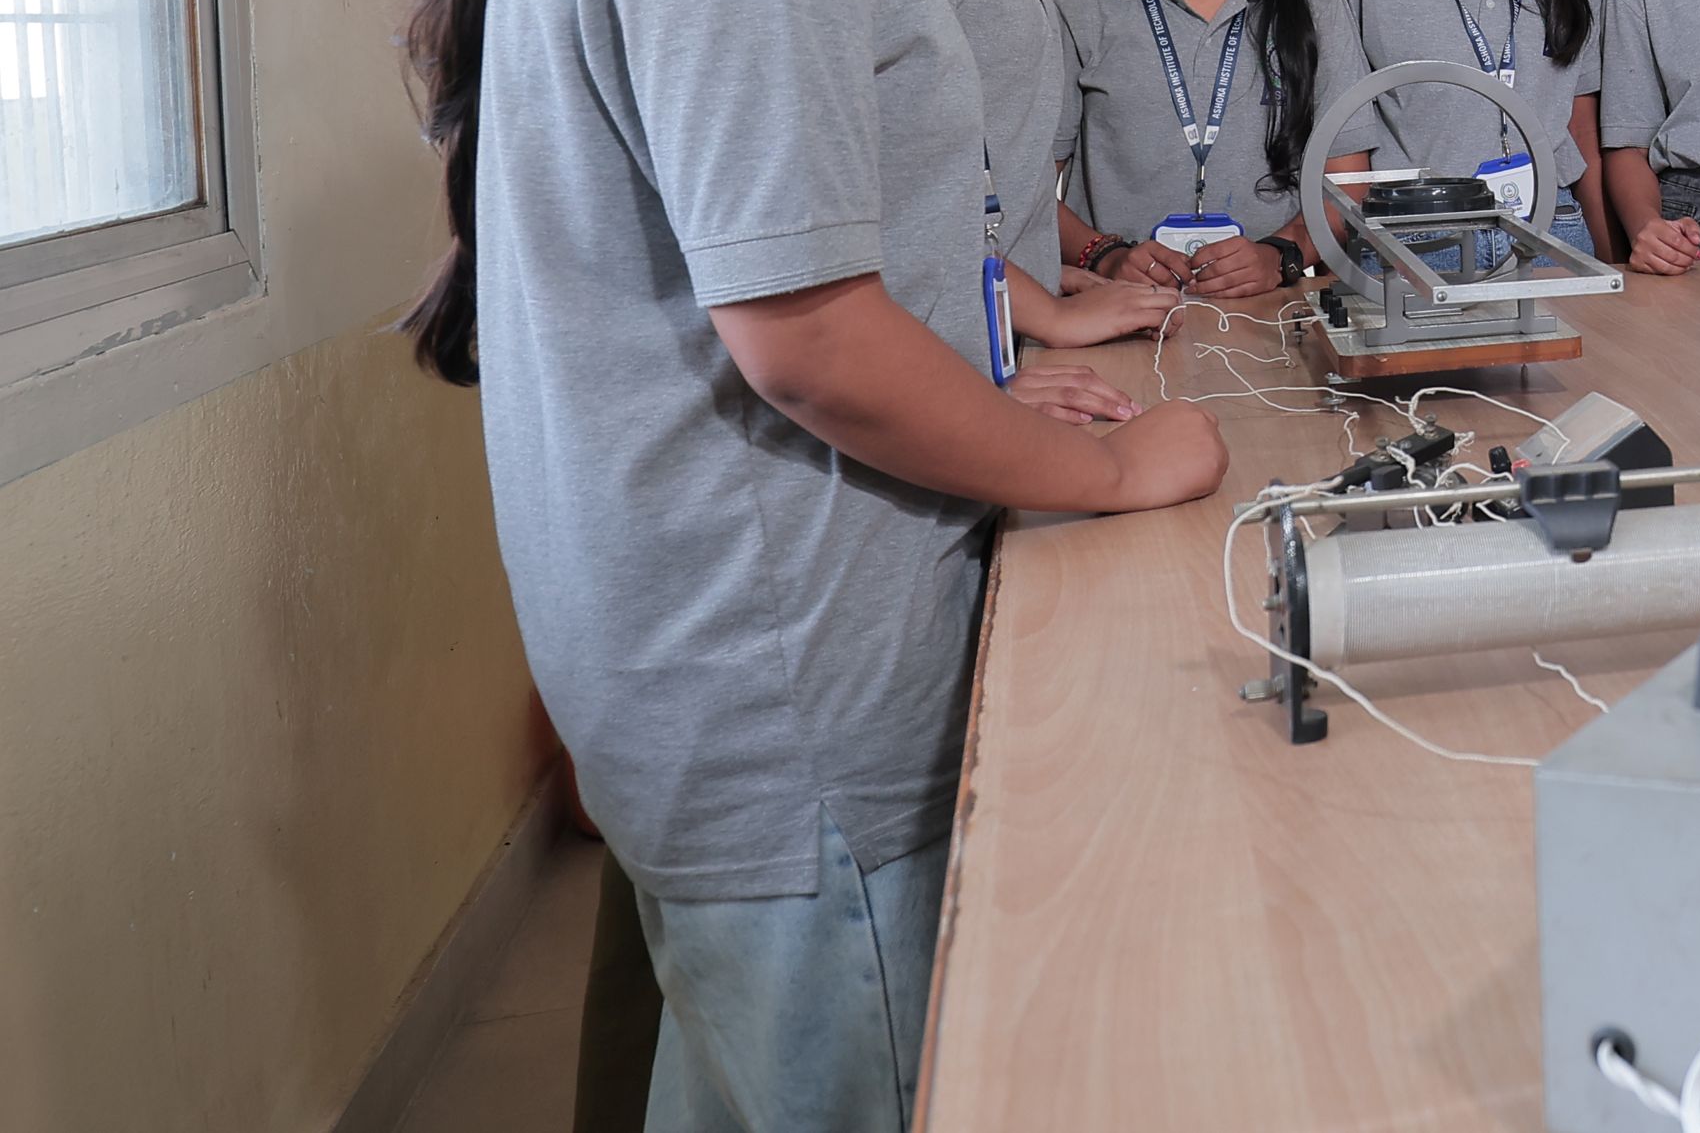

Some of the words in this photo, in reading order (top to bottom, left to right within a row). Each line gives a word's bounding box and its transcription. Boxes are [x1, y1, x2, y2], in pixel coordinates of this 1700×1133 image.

[1158, 37, 1168, 46] OF
[1474, 36, 1492, 66] ASHOKA
[1162, 47, 1181, 86] INSTITUTE
[1212, 87, 1226, 119] ASHOKA
[1220, 47, 1236, 85] INSTITUTE
[1228, 35, 1238, 45] OF
[1175, 87, 1191, 119] ASHOKA
